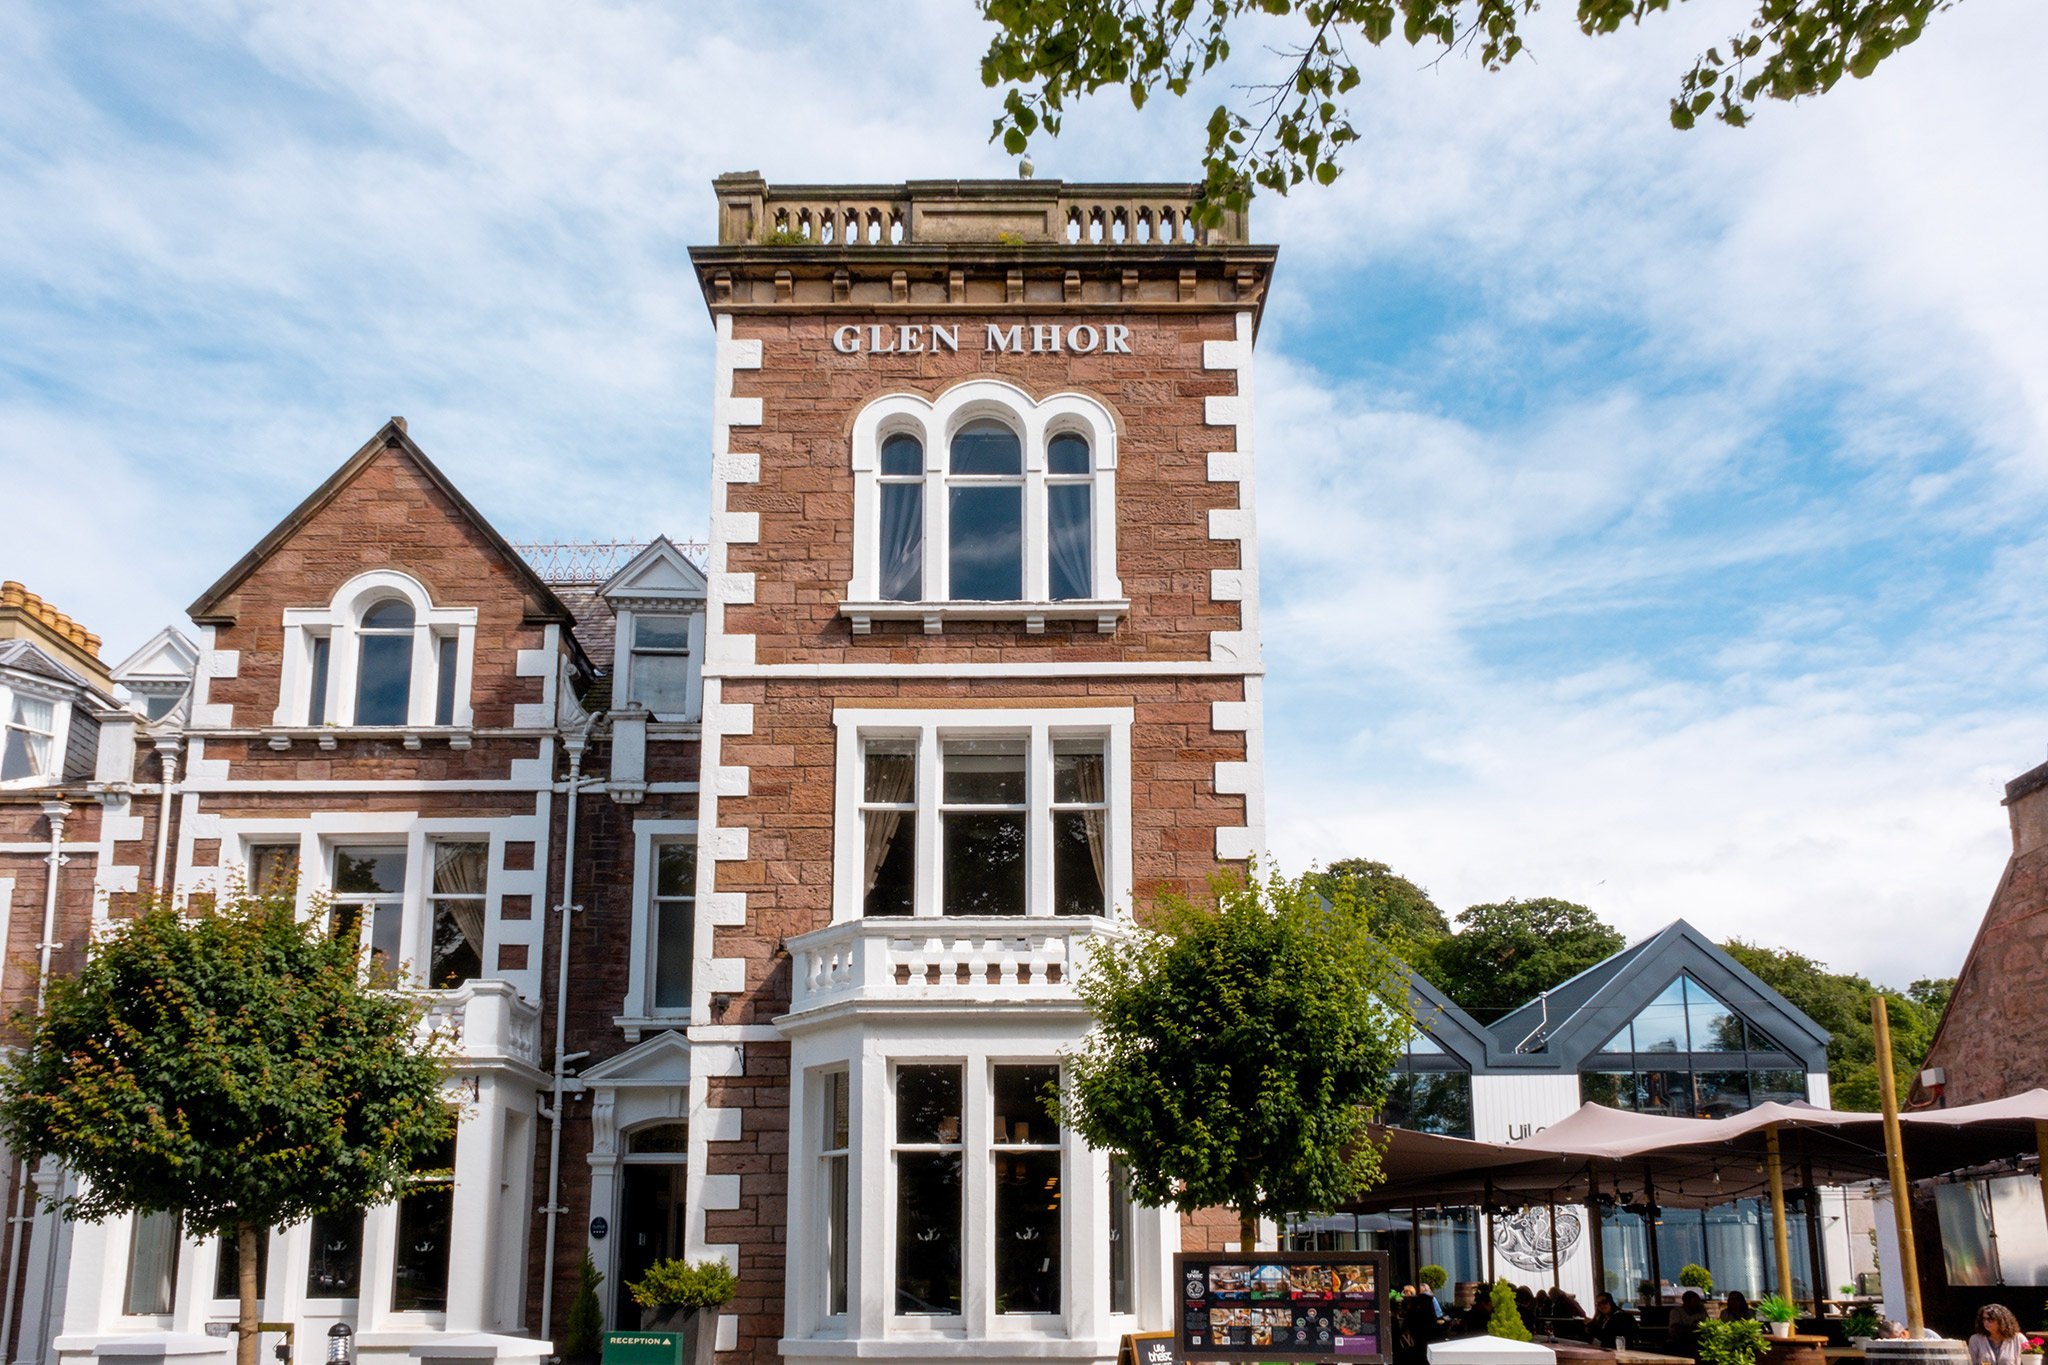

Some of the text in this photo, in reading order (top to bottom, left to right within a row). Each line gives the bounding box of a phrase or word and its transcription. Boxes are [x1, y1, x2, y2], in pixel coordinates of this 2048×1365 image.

[833, 323, 1132, 353] GLEN MHOR
[610, 1337, 660, 1345] RECEPTION
